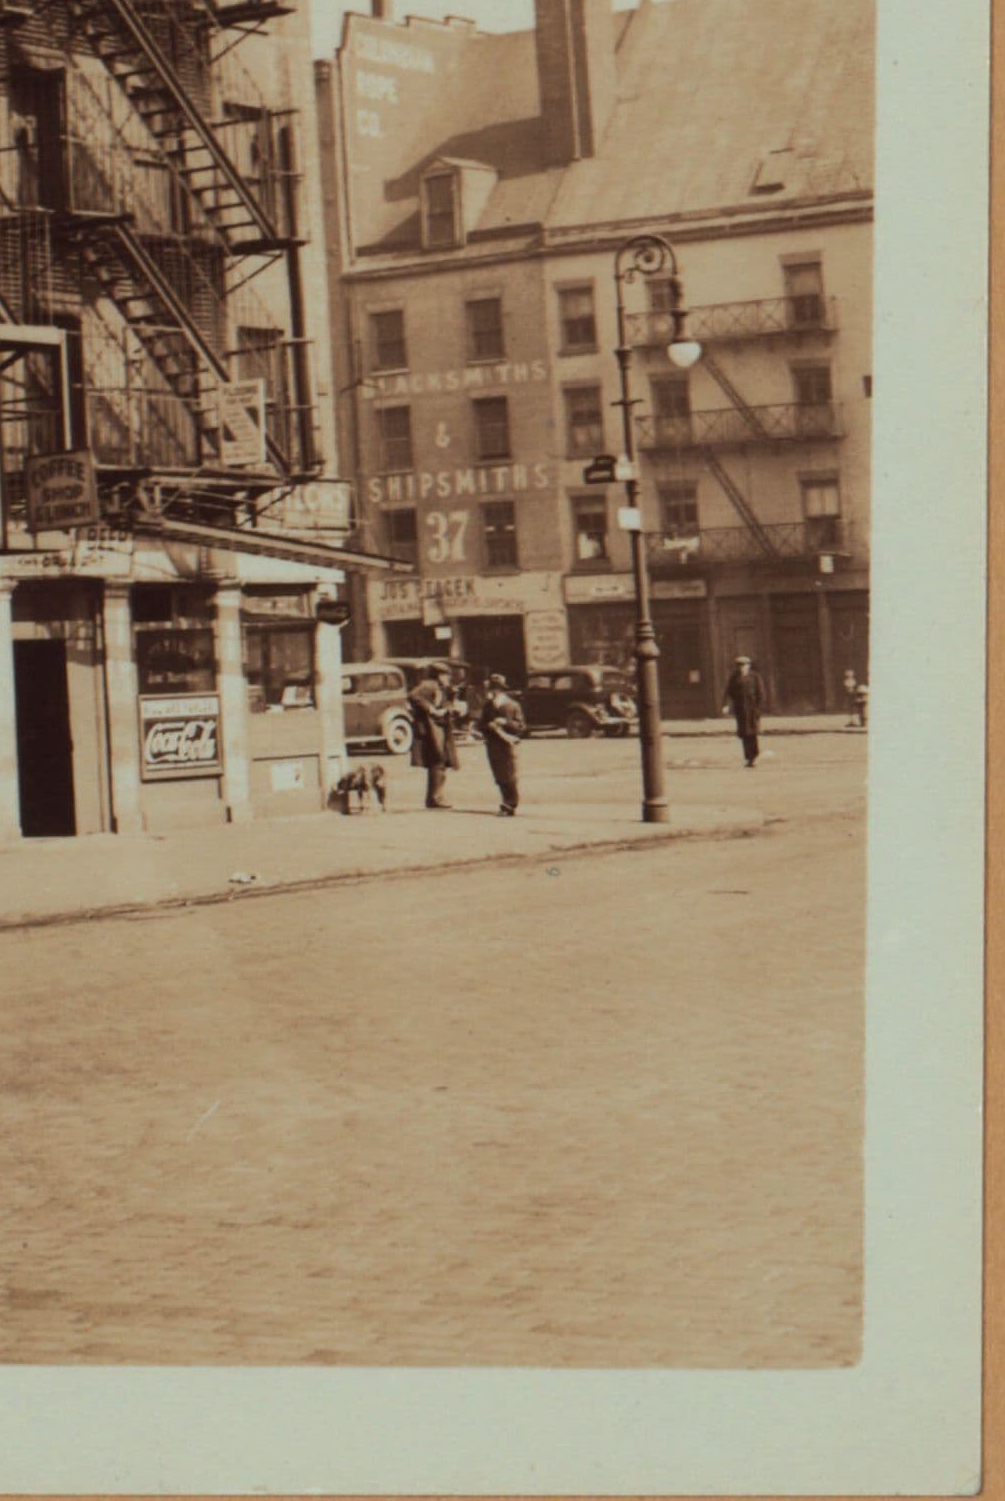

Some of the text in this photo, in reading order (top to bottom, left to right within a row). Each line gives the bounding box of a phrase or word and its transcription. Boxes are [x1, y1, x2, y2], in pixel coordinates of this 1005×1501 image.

[358, 360, 545, 399] BLACKSMITHS
[31, 457, 86, 489] COFFEE
[368, 463, 549, 503] SHIPSMITHS
[425, 509, 470, 563] 37
